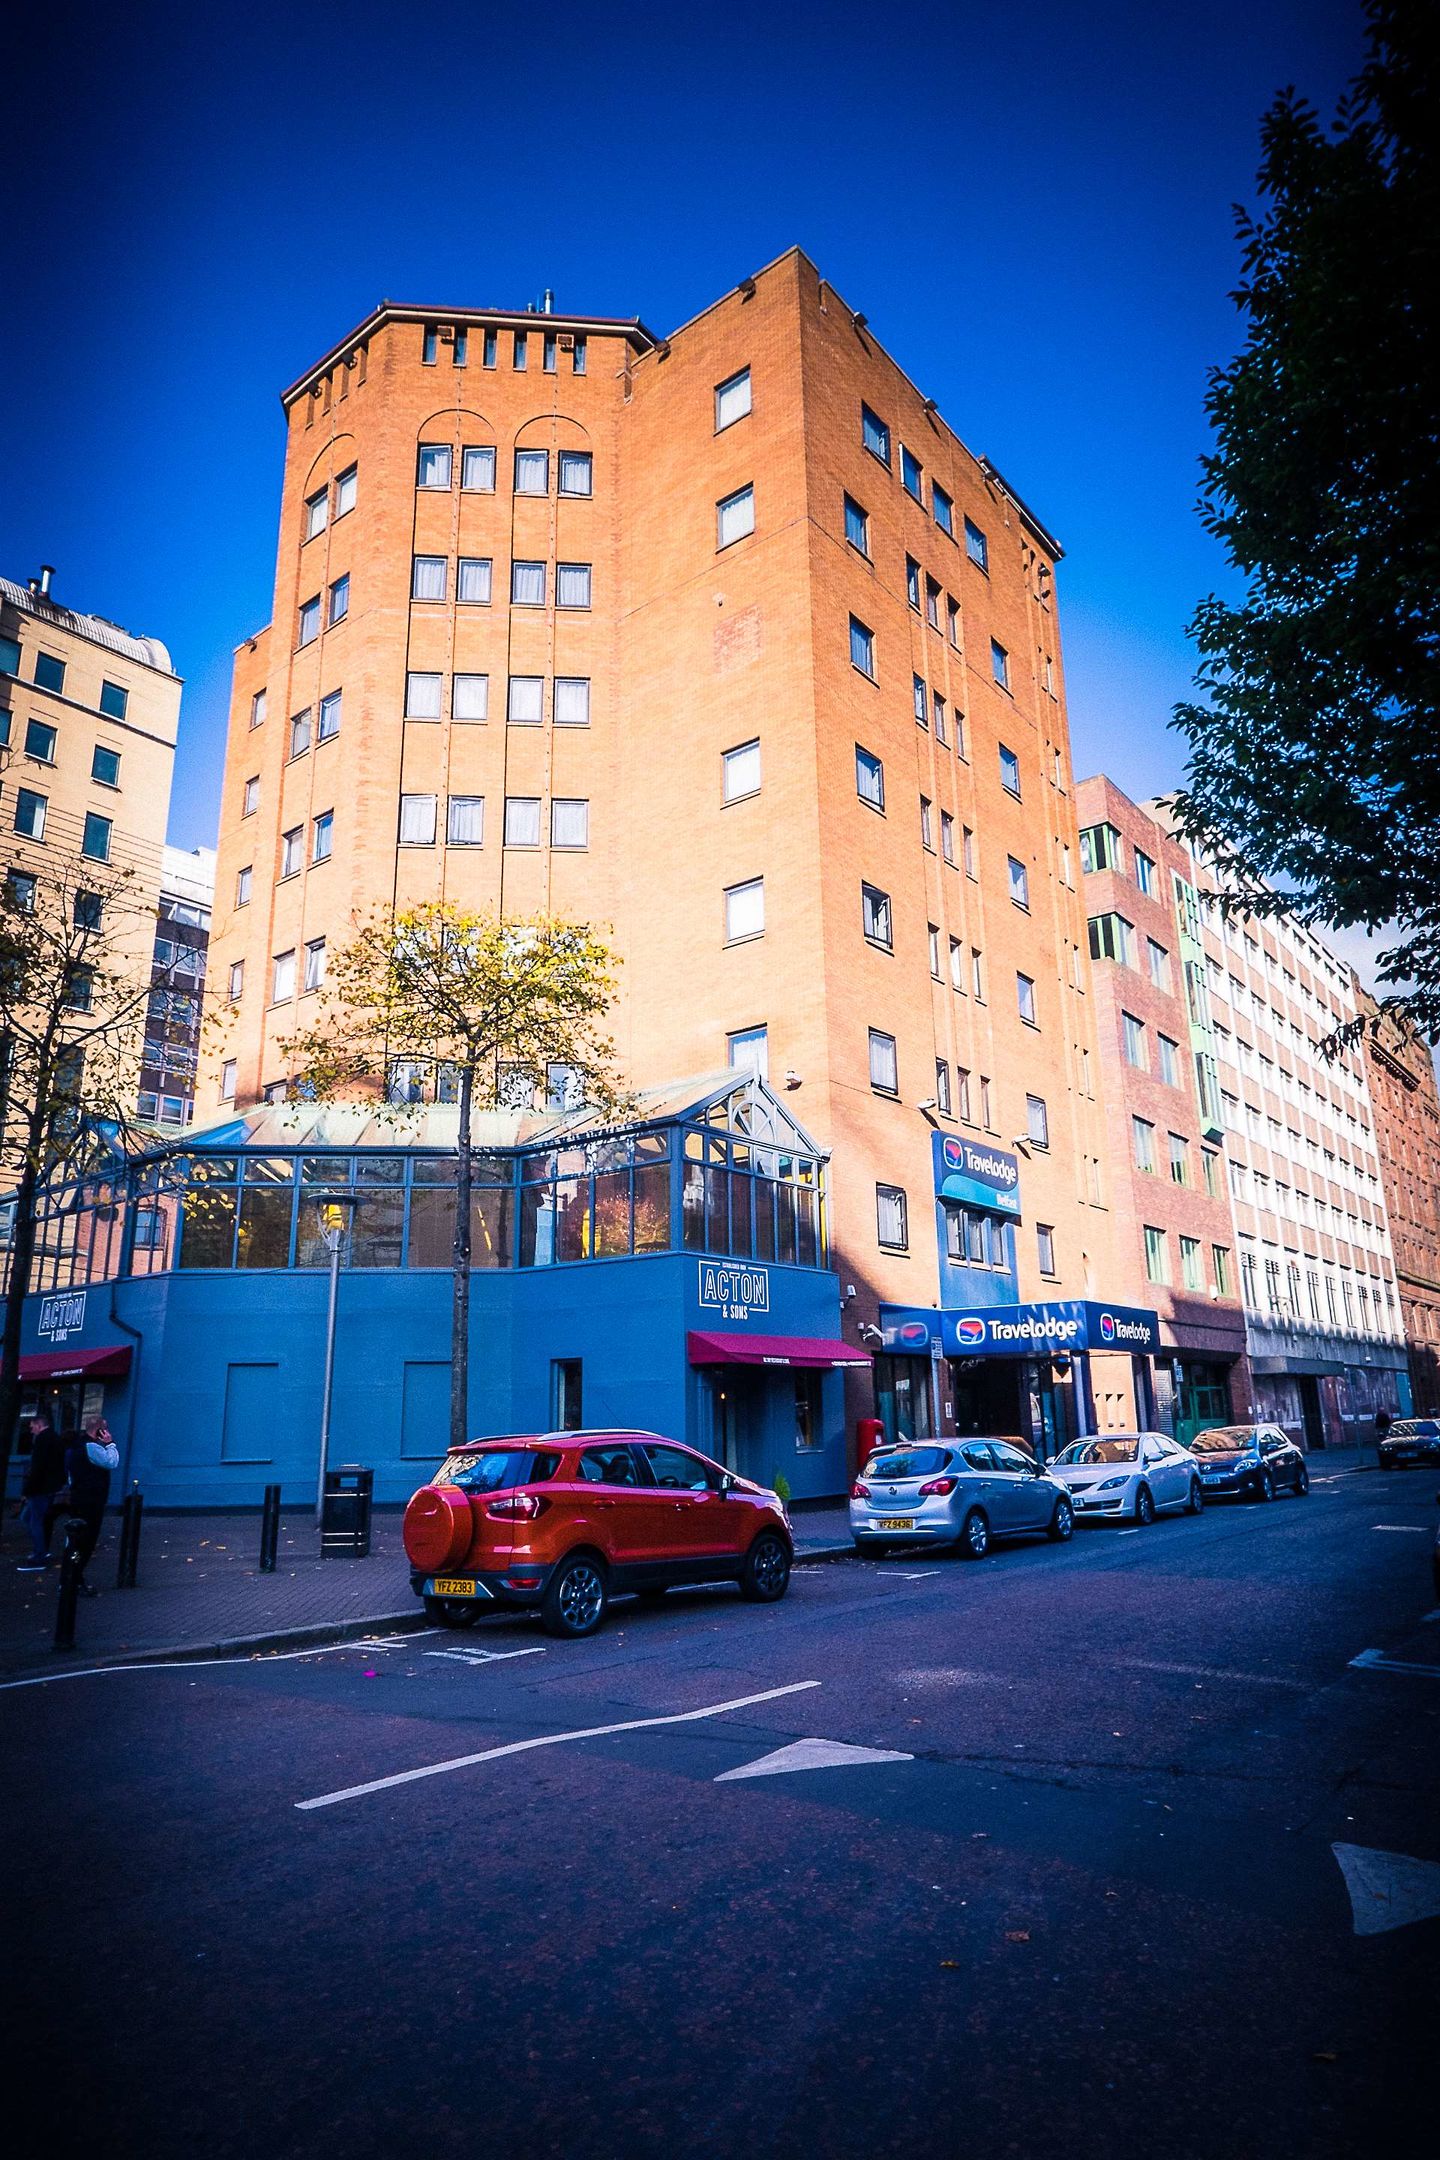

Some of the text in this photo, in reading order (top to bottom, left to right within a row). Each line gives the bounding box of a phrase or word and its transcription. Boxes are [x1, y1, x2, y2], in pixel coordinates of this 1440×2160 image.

[964, 1147, 1017, 1185] Travelodge
[704, 1269, 765, 1305] ACTON
[41, 1298, 83, 1329] ACTON
[722, 1304, 748, 1320] & SONS
[987, 1317, 1079, 1341] Travelodge
[1113, 1318, 1151, 1345] Travelodge
[437, 1581, 451, 1592] YFZ
